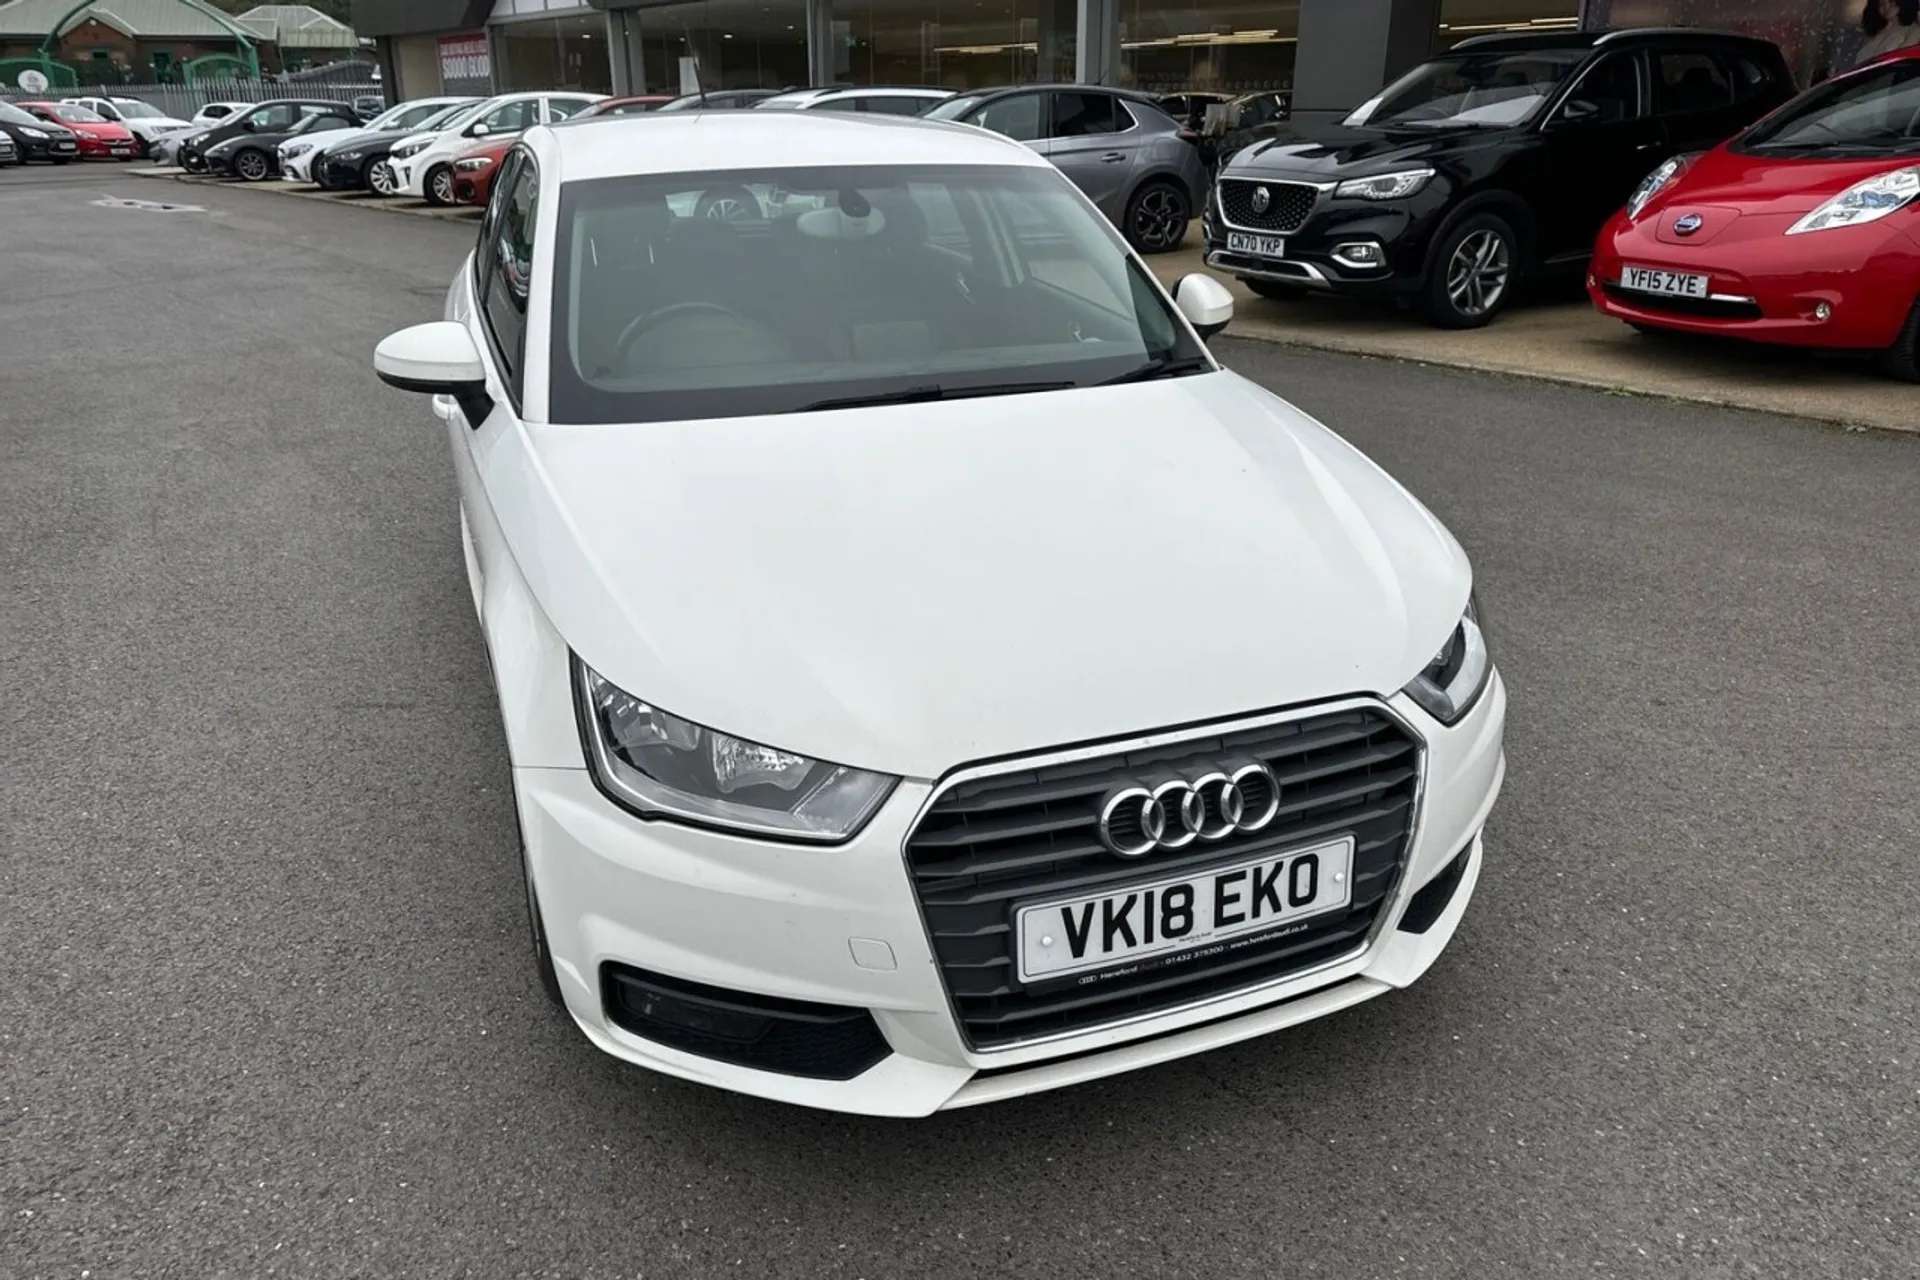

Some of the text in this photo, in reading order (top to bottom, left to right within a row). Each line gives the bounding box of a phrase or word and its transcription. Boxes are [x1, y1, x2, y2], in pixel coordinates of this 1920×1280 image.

[1231, 233, 1280, 253] CN70 YKP
[1630, 268, 1698, 293] YF15 ZYE
[1060, 853, 1319, 959] VK18 EKO
